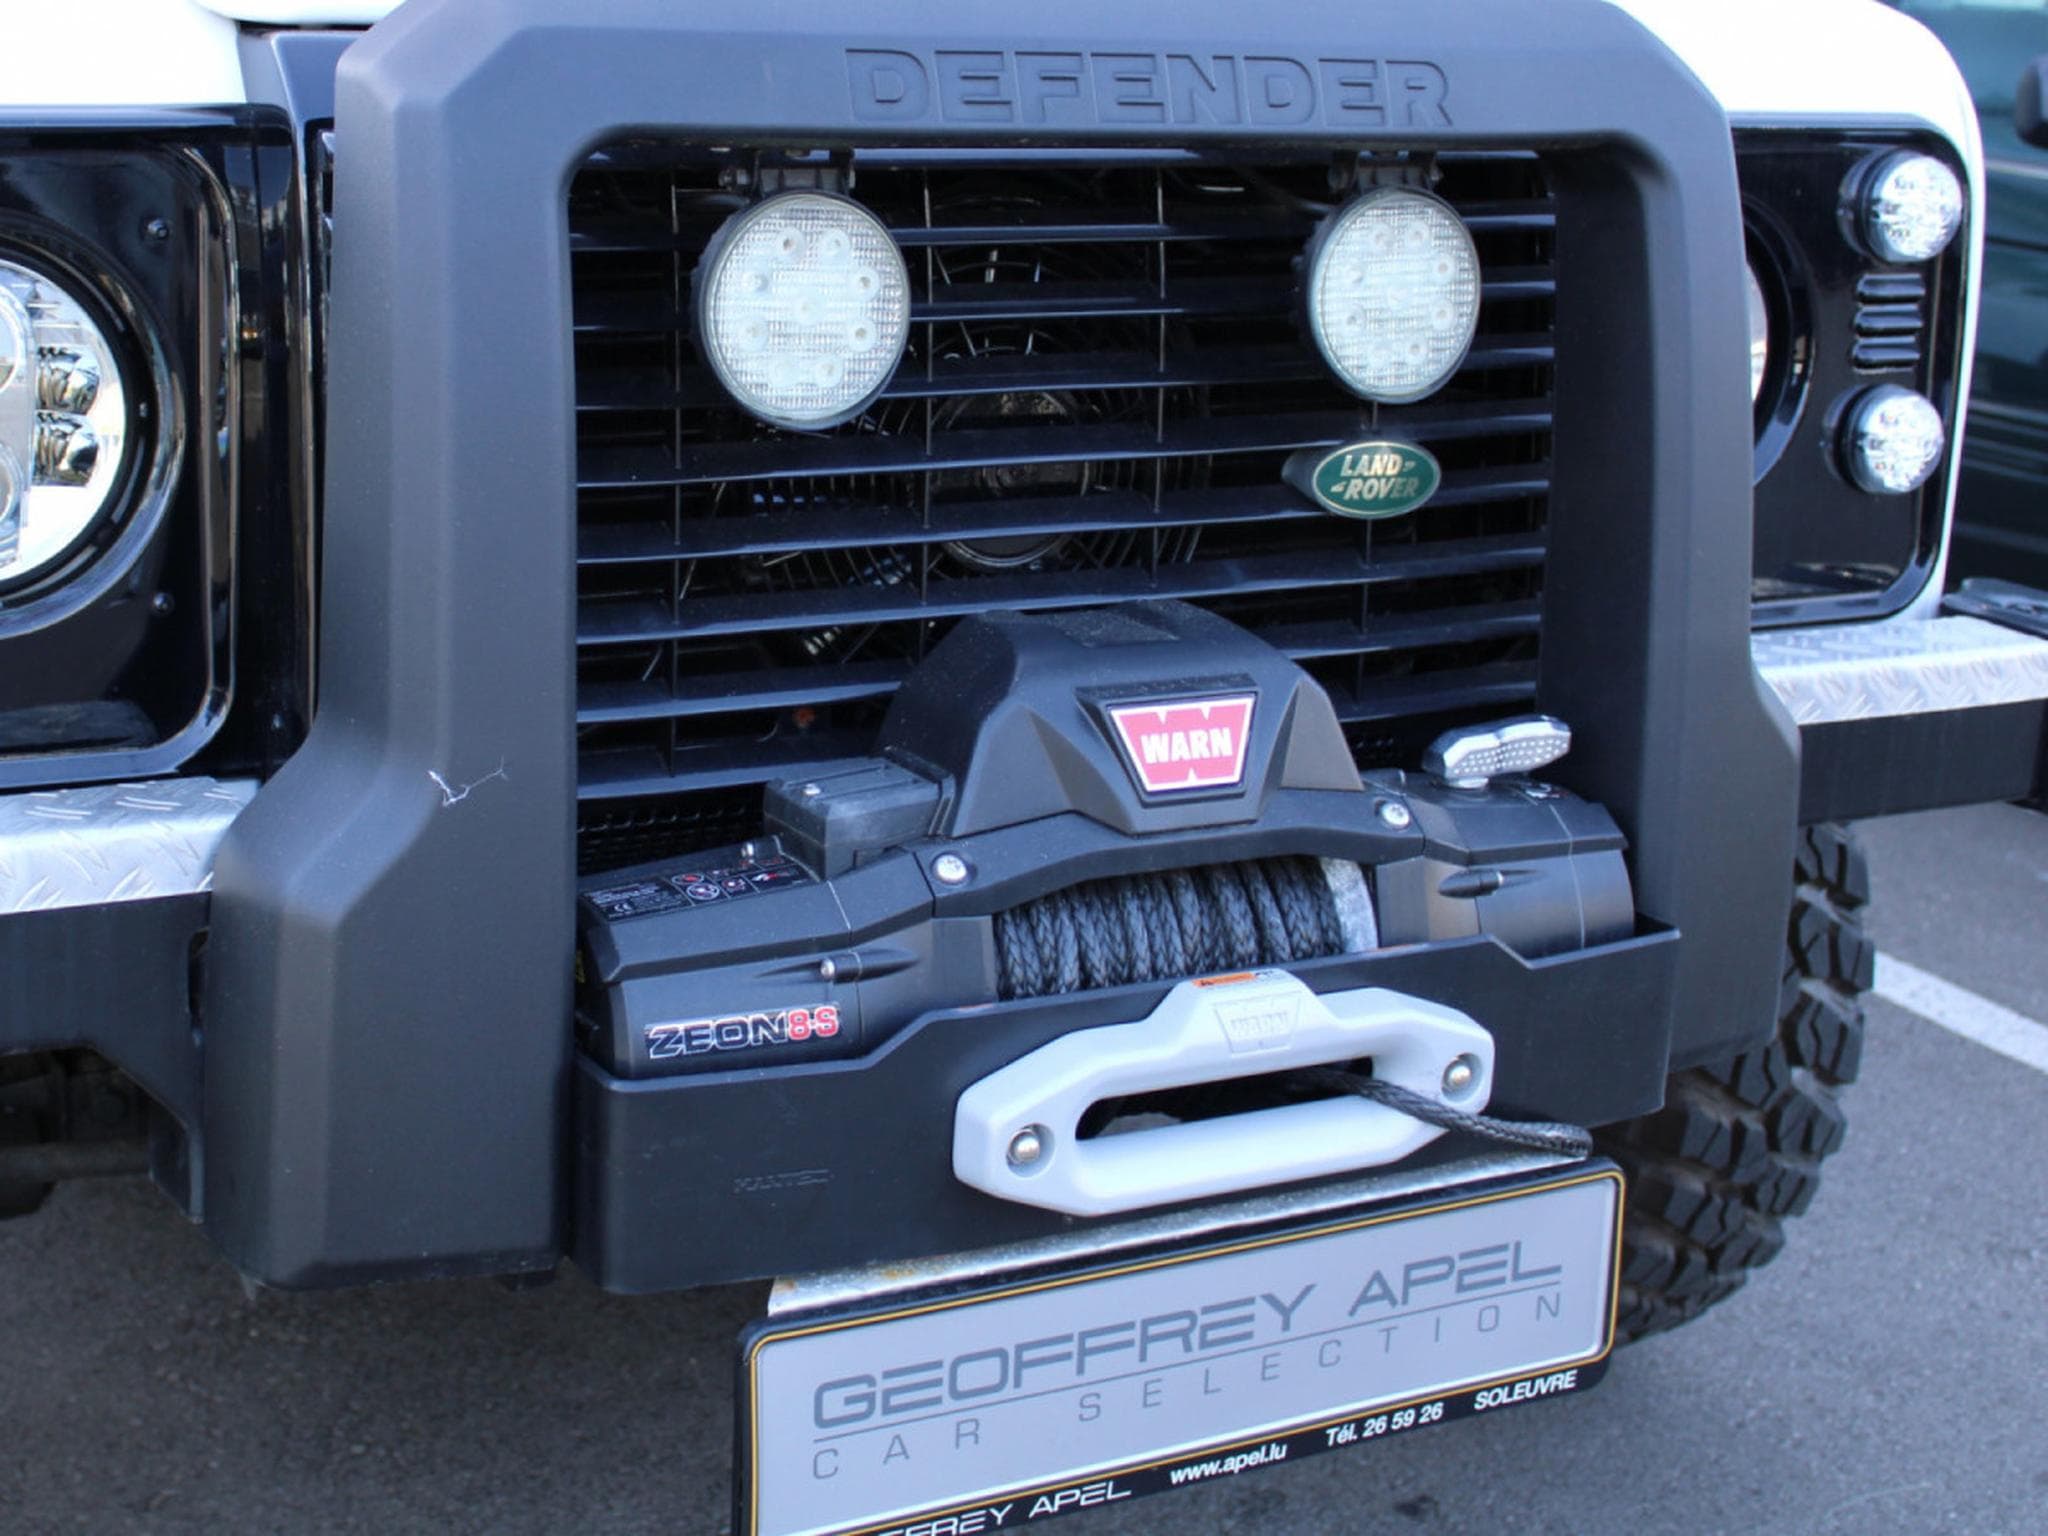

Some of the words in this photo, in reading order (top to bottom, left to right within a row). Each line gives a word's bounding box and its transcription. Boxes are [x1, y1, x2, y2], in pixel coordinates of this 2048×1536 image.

[845, 48, 1453, 127] DEFENDER
[1340, 453, 1403, 477] LAND
[1343, 477, 1419, 501] ROVER
[1140, 726, 1233, 764] WARN
[814, 1284, 1317, 1430] GEOFFREY
[1348, 1240, 1562, 1318] APEL
[812, 1418, 981, 1480] CAR
[1077, 1292, 1561, 1423] SELECTION
[1028, 1480, 1132, 1518] APEL
[1169, 1443, 1288, 1485] www.apel.lu
[1325, 1425, 1359, 1447] Tél.
[1362, 1416, 1386, 1439] 26
[1390, 1409, 1415, 1432] 59
[1418, 1402, 1443, 1425] 26
[1473, 1369, 1579, 1411] SOLEUVRE
